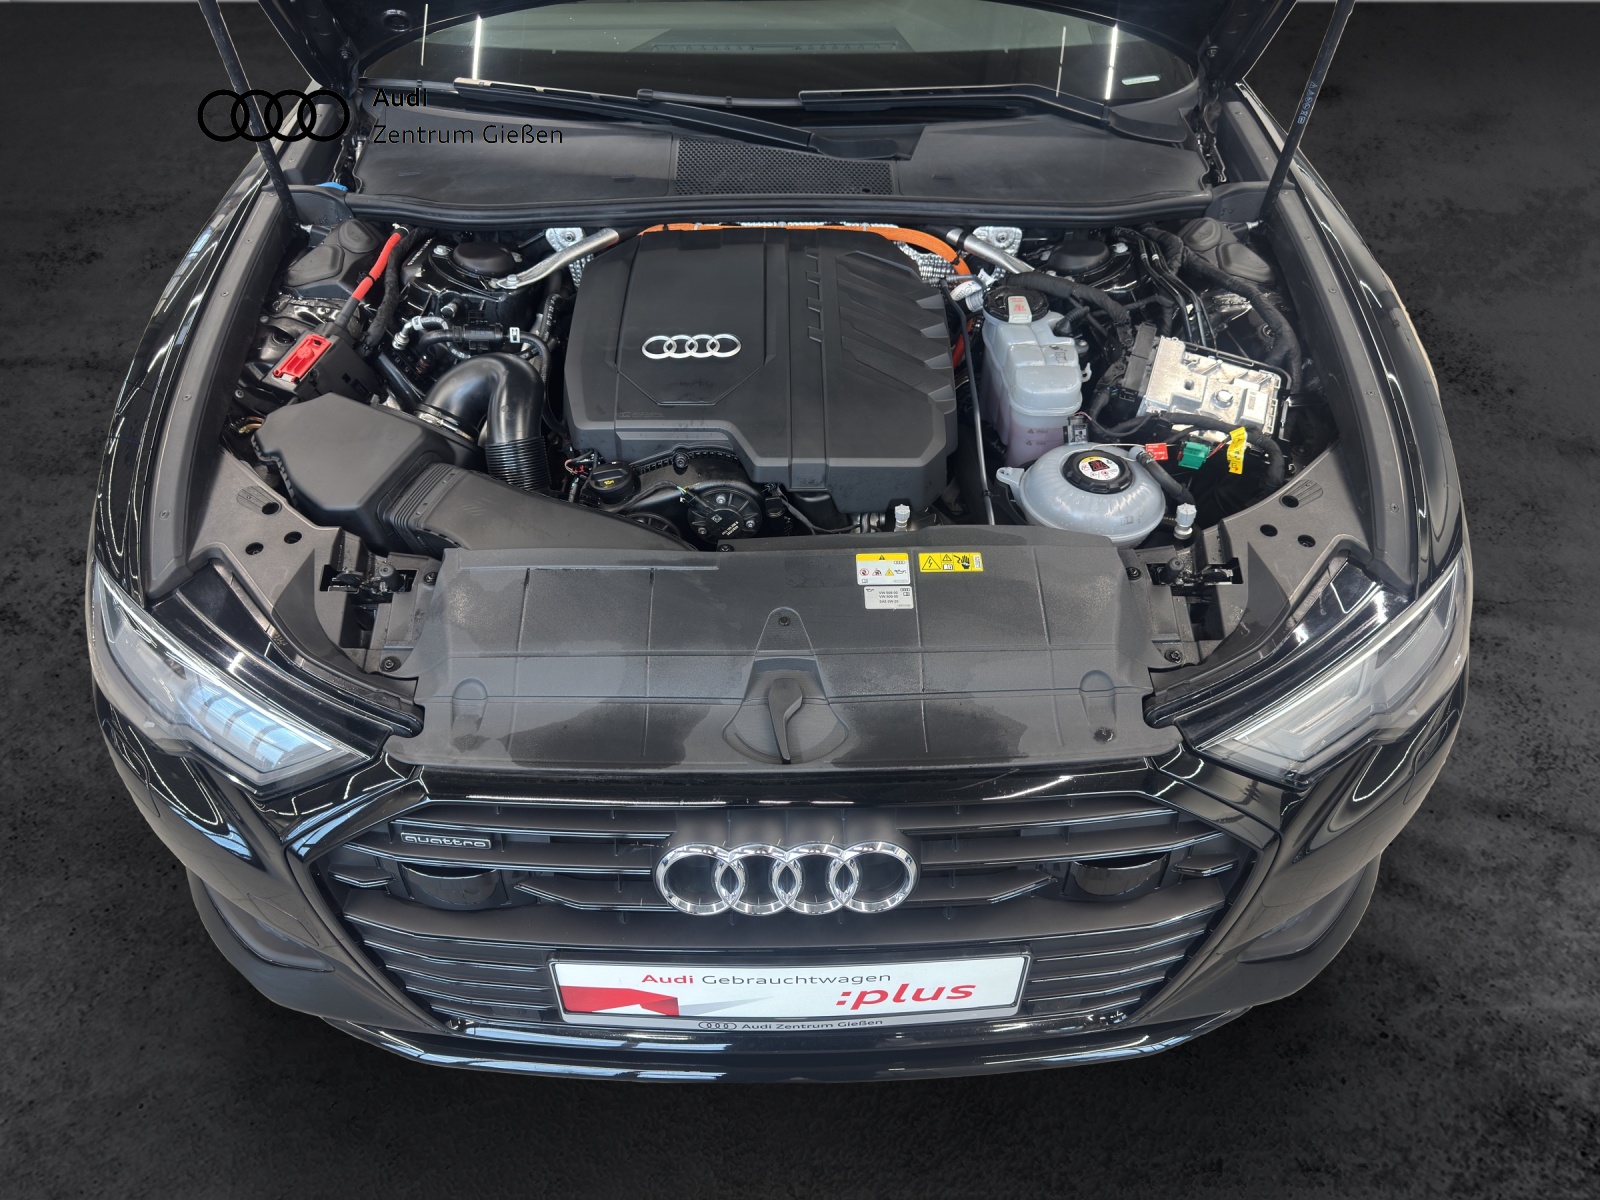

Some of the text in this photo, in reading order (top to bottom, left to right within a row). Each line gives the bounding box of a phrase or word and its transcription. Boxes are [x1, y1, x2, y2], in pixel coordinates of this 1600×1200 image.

[404, 835, 486, 848] quattro
[641, 973, 891, 986] Audi Gebrauchtwagen
[776, 1022, 834, 1030] Zentrum
[838, 1019, 883, 1028] Gießen
